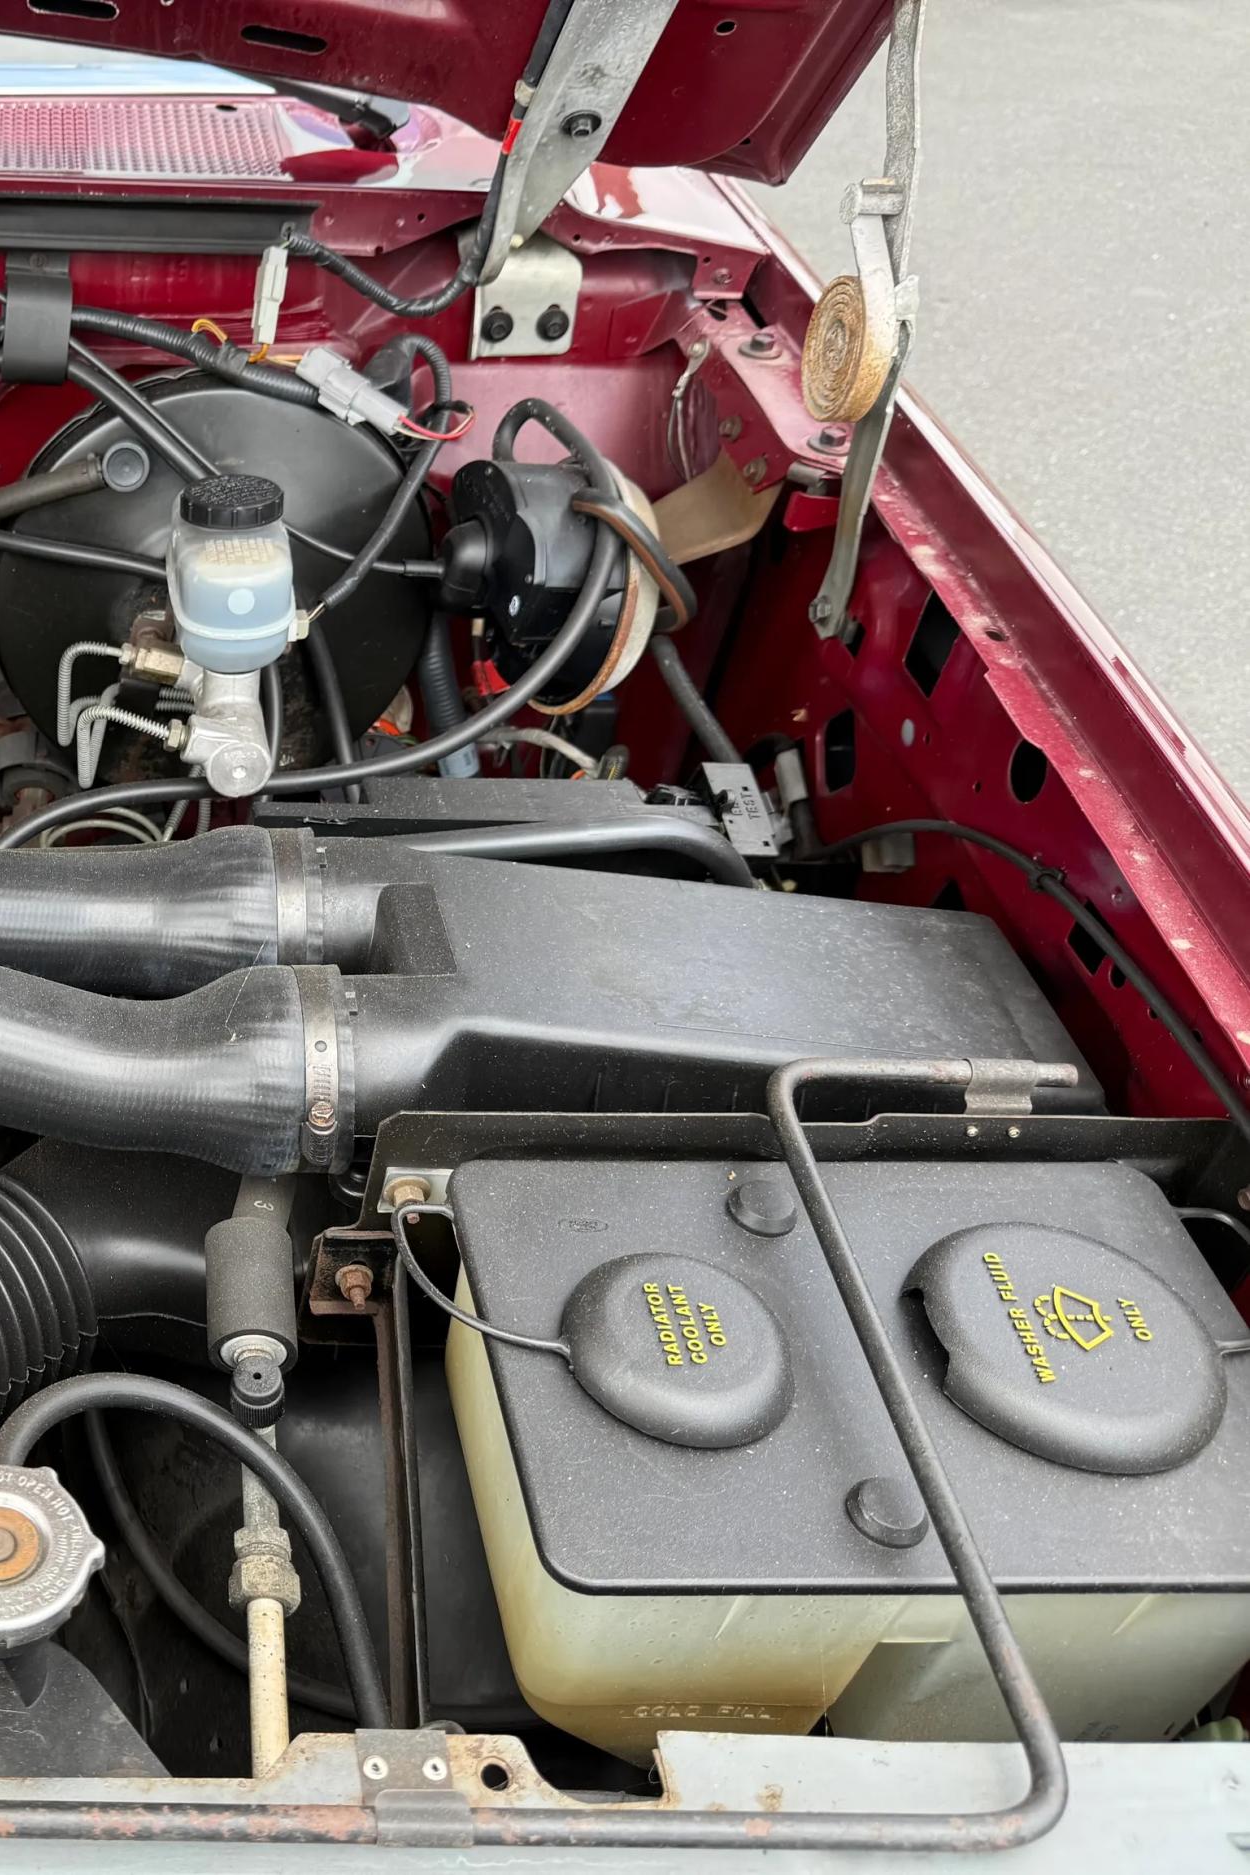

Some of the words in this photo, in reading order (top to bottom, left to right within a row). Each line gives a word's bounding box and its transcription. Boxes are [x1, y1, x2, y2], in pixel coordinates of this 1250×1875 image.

[982, 1251, 1019, 1302] FLUID
[642, 1281, 684, 1366] RADIATOR
[666, 1283, 709, 1365] COOLANT
[697, 1301, 728, 1347] ONLY
[1116, 1297, 1154, 1342] ONLY
[1008, 1306, 1058, 1384] WASHER
[17, 1475, 55, 1501] OPEN
[50, 1497, 75, 1522] HOT
[633, 1704, 701, 1719] COLD
[716, 1704, 771, 1720] FILL
